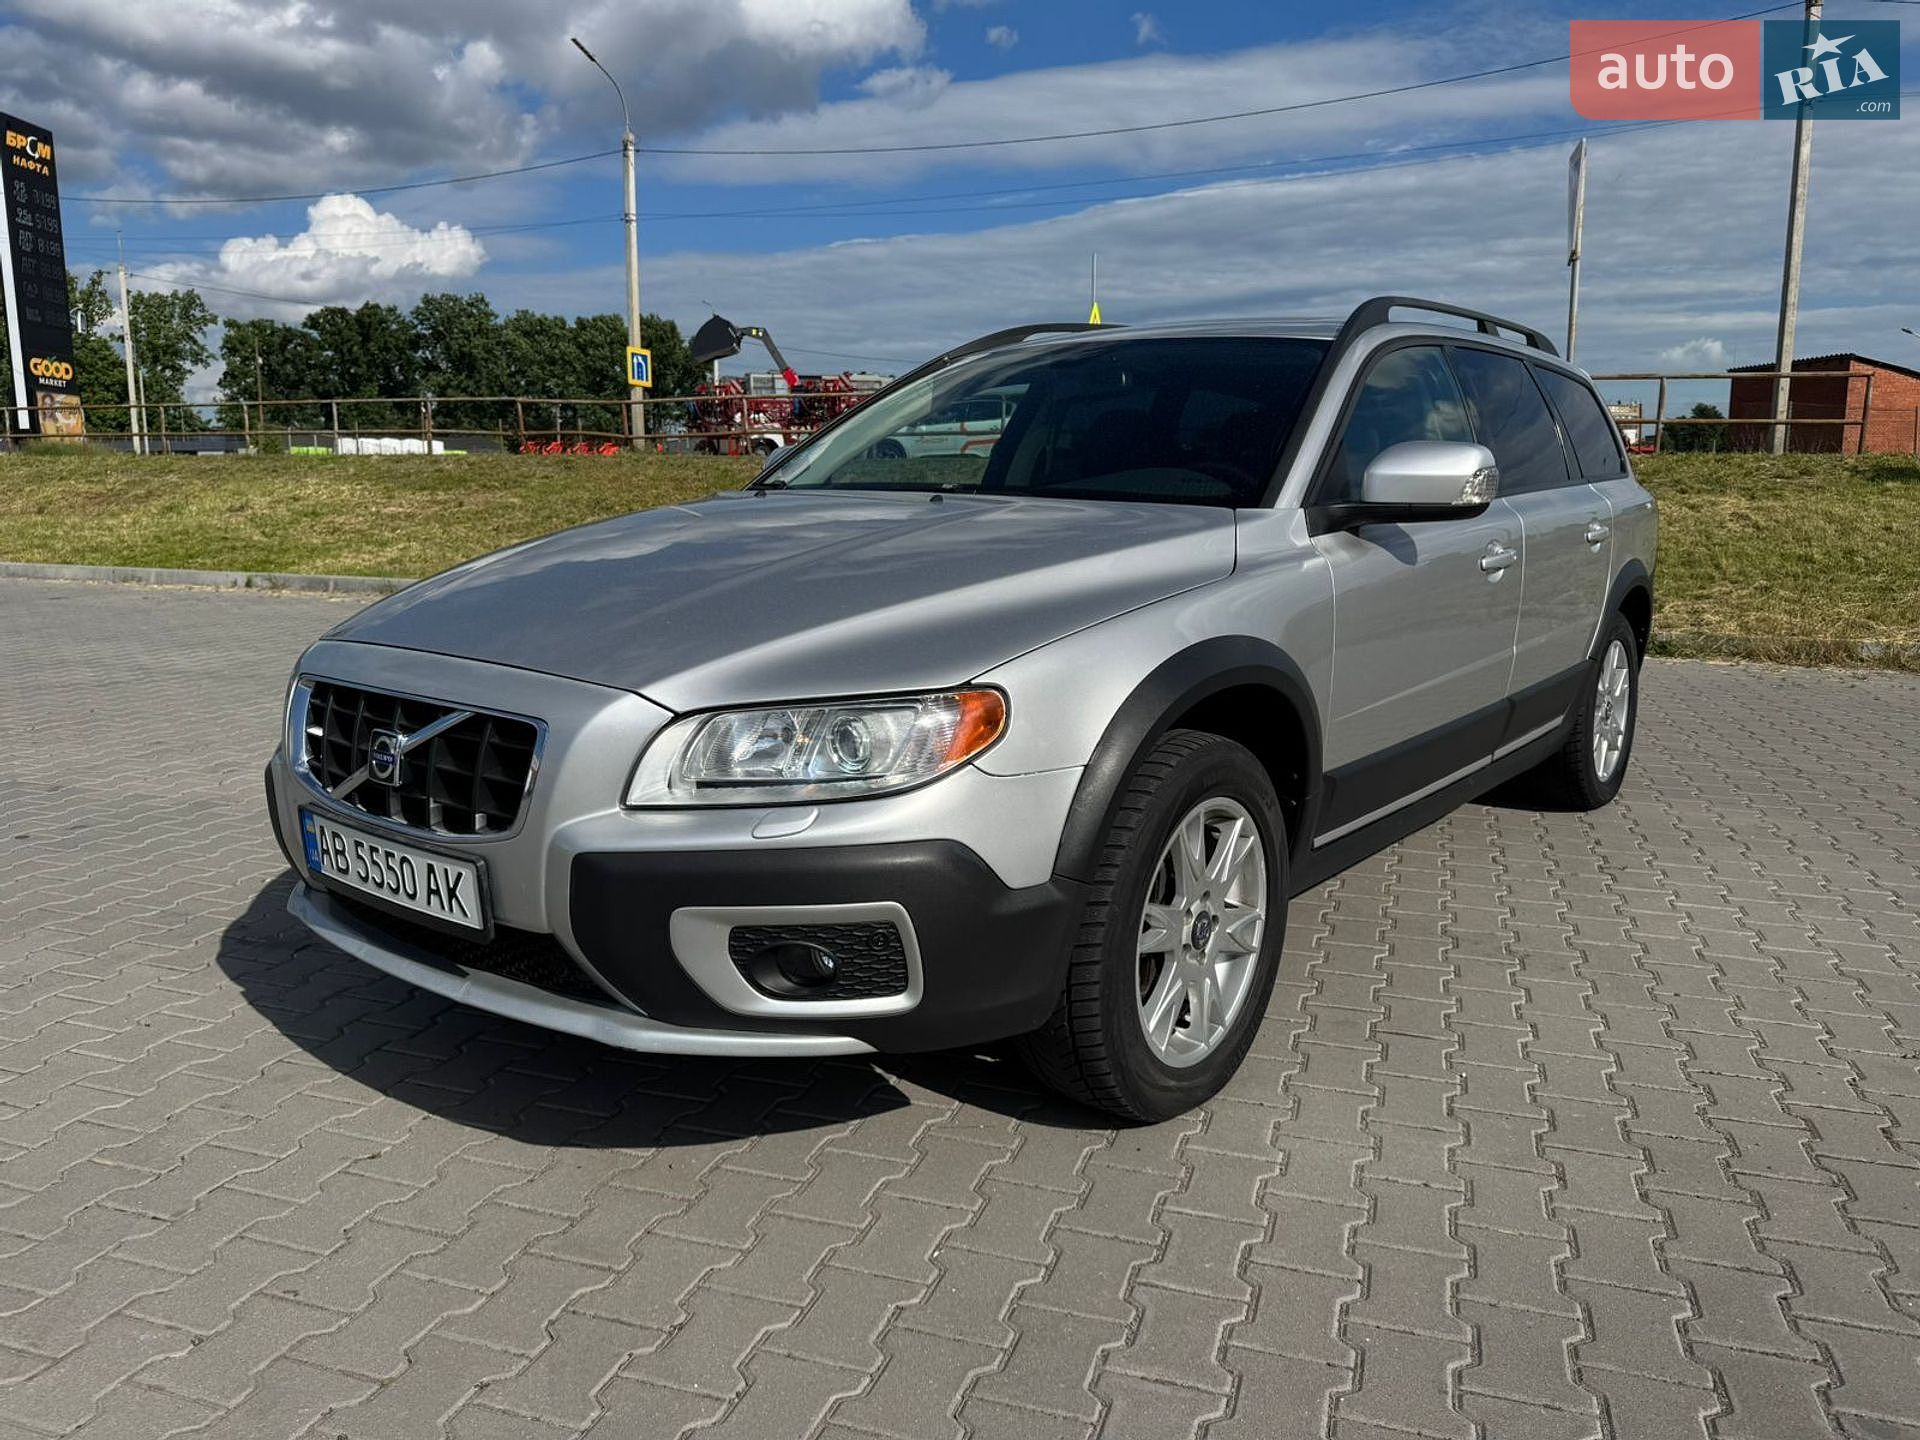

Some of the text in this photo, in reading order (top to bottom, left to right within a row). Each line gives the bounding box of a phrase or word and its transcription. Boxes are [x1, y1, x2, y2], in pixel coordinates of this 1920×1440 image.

[12, 154, 50, 177] НАФТА
[30, 357, 73, 380] GOOD
[39, 377, 66, 388] MARKET
[319, 825, 471, 918] AB 5550 AK
